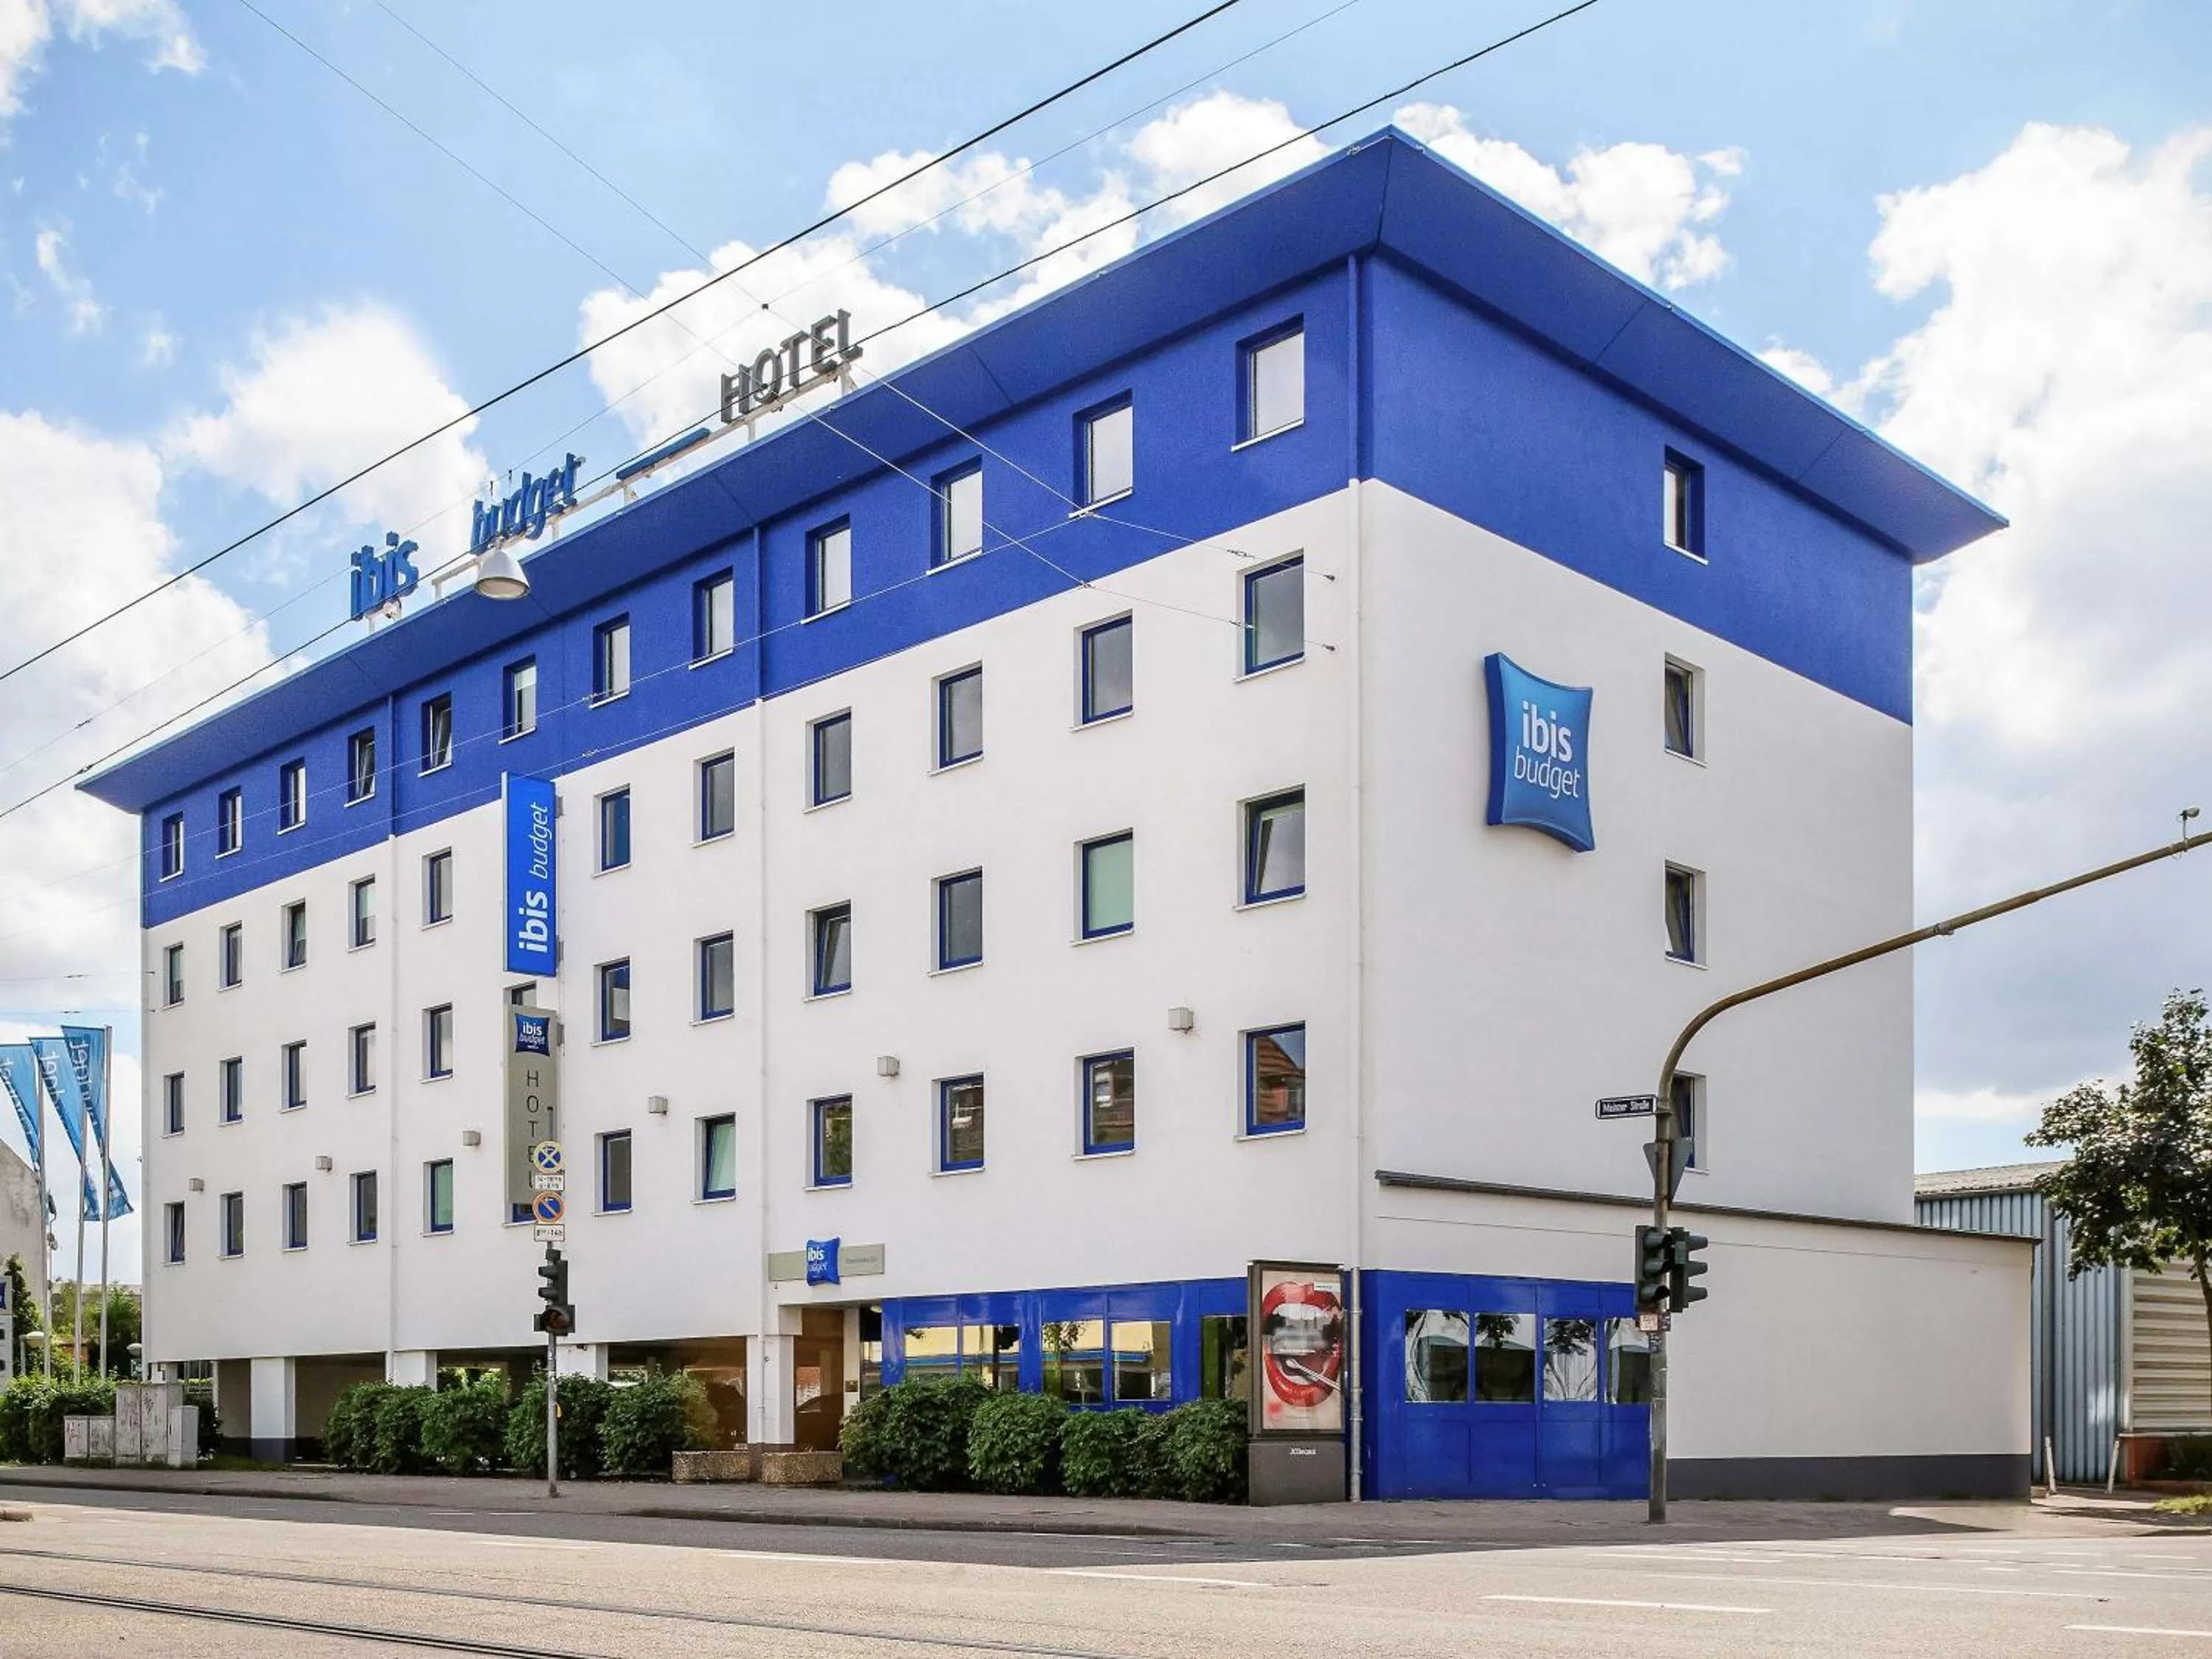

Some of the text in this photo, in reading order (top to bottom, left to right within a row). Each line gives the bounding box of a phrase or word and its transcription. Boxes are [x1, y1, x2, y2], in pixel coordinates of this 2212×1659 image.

[351, 308, 863, 621] ibis budget HOTEL
[1522, 700, 1573, 762] ibis
[1514, 745, 1581, 799] budget
[518, 801, 552, 953] ibis budget
[522, 1021, 543, 1036] ibis
[807, 1246, 825, 1261] ibis
